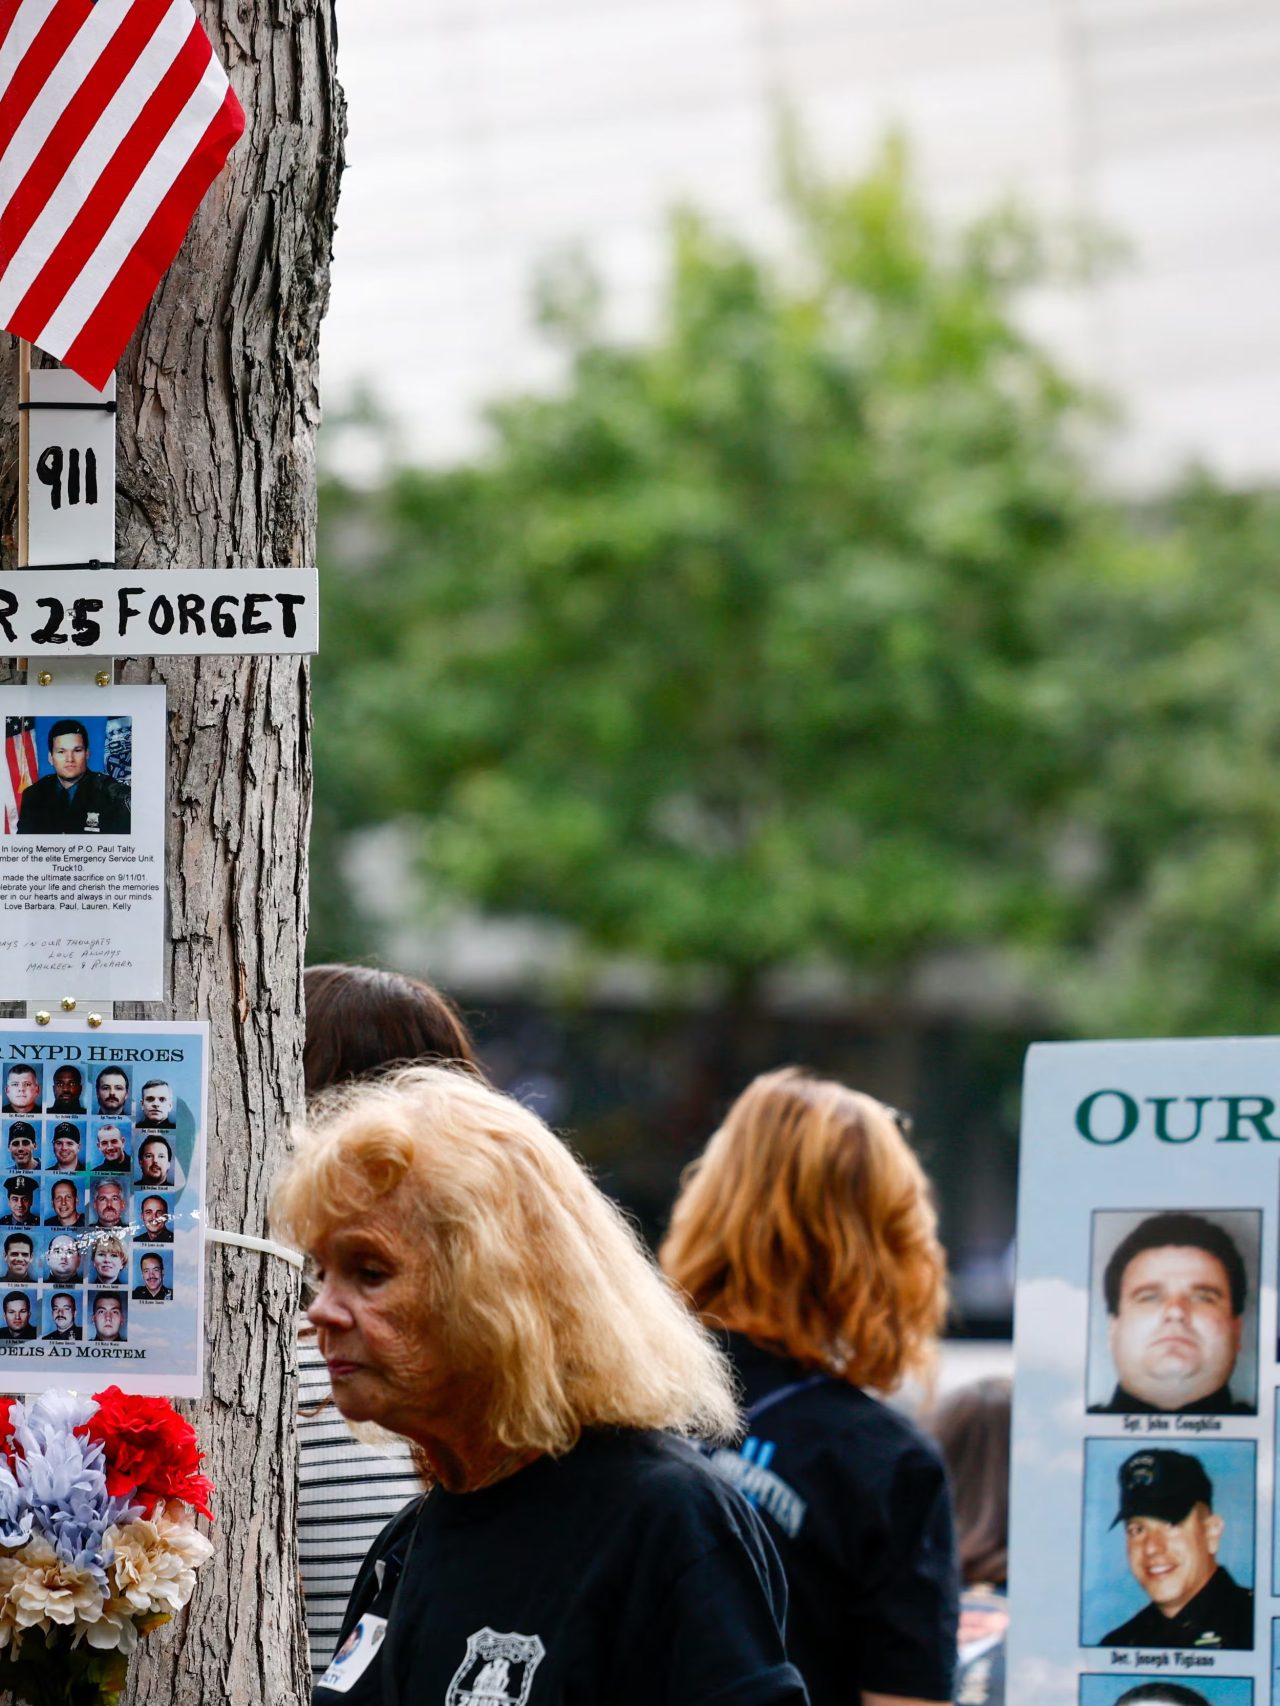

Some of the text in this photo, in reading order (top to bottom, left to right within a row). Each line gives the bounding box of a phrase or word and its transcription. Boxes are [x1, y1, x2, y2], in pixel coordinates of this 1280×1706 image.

[36, 445, 99, 510] 911
[30, 597, 105, 647] 25
[117, 587, 306, 639] FORGET
[2, 845, 8, 853] In
[11, 845, 34, 854] loving
[36, 845, 66, 854] Memory
[68, 845, 76, 853] of
[98, 845, 114, 853] Paul
[117, 845, 135, 854] Talty
[64, 855, 106, 864] Emergency
[77, 893, 103, 901] always
[113, 903, 131, 911] Kelly
[9, 1044, 82, 1061] NYPD
[87, 1046, 184, 1062] HEROES
[1074, 1088, 1280, 1146] OUR
[48, 1346, 72, 1357] AD
[76, 1347, 147, 1359] MORTEM
